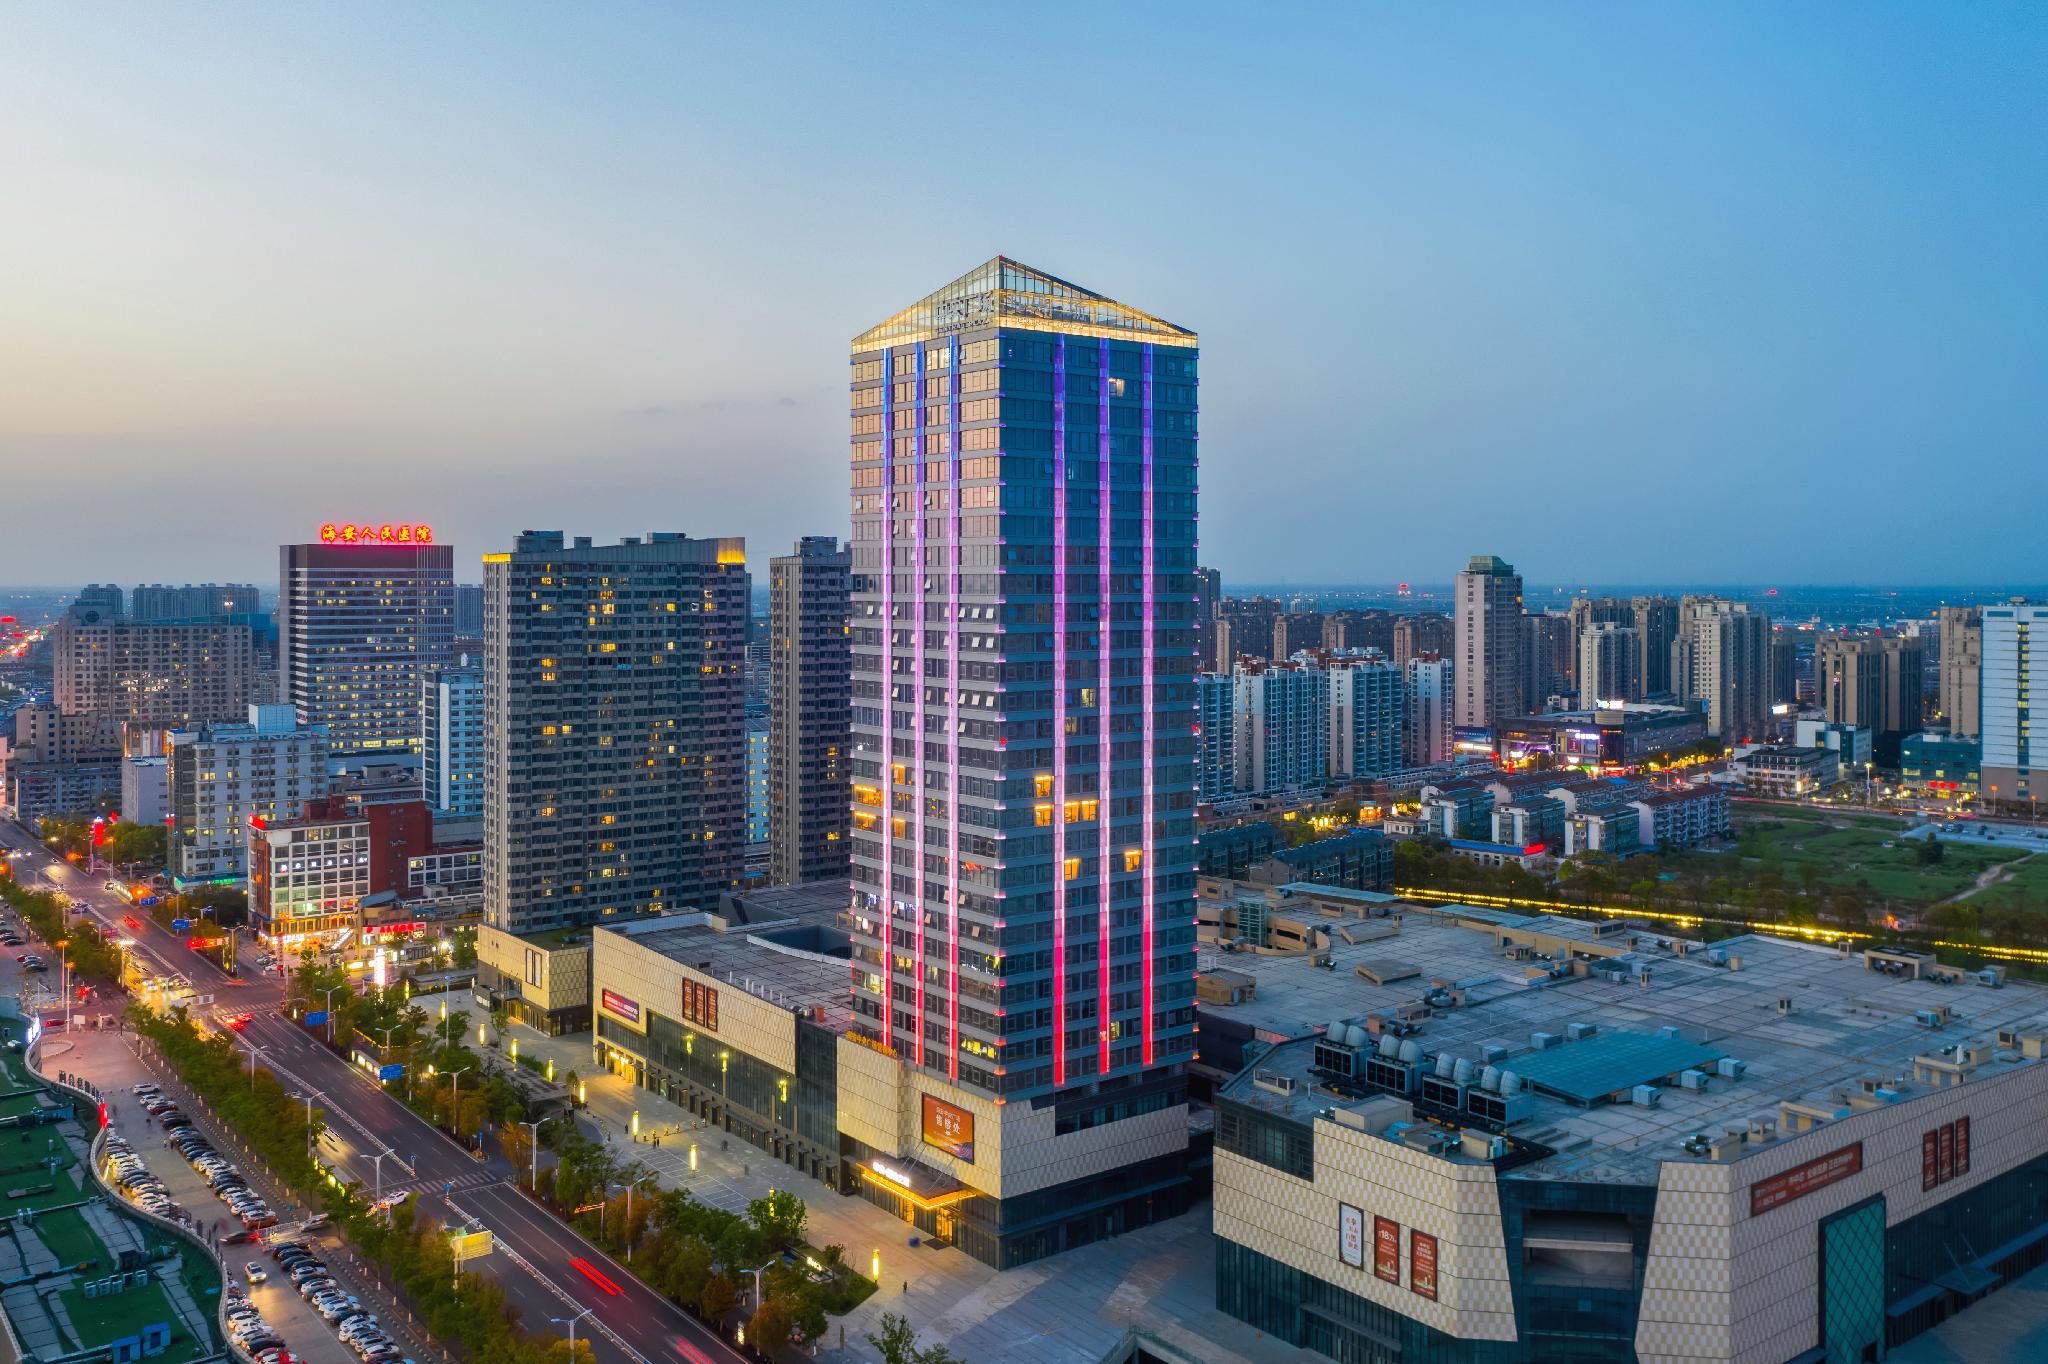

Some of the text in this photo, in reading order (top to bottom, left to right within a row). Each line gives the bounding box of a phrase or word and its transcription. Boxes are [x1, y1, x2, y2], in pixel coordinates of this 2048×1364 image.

[321, 524, 433, 543] 海安人民医院
[935, 1114, 961, 1133] 售楼处
